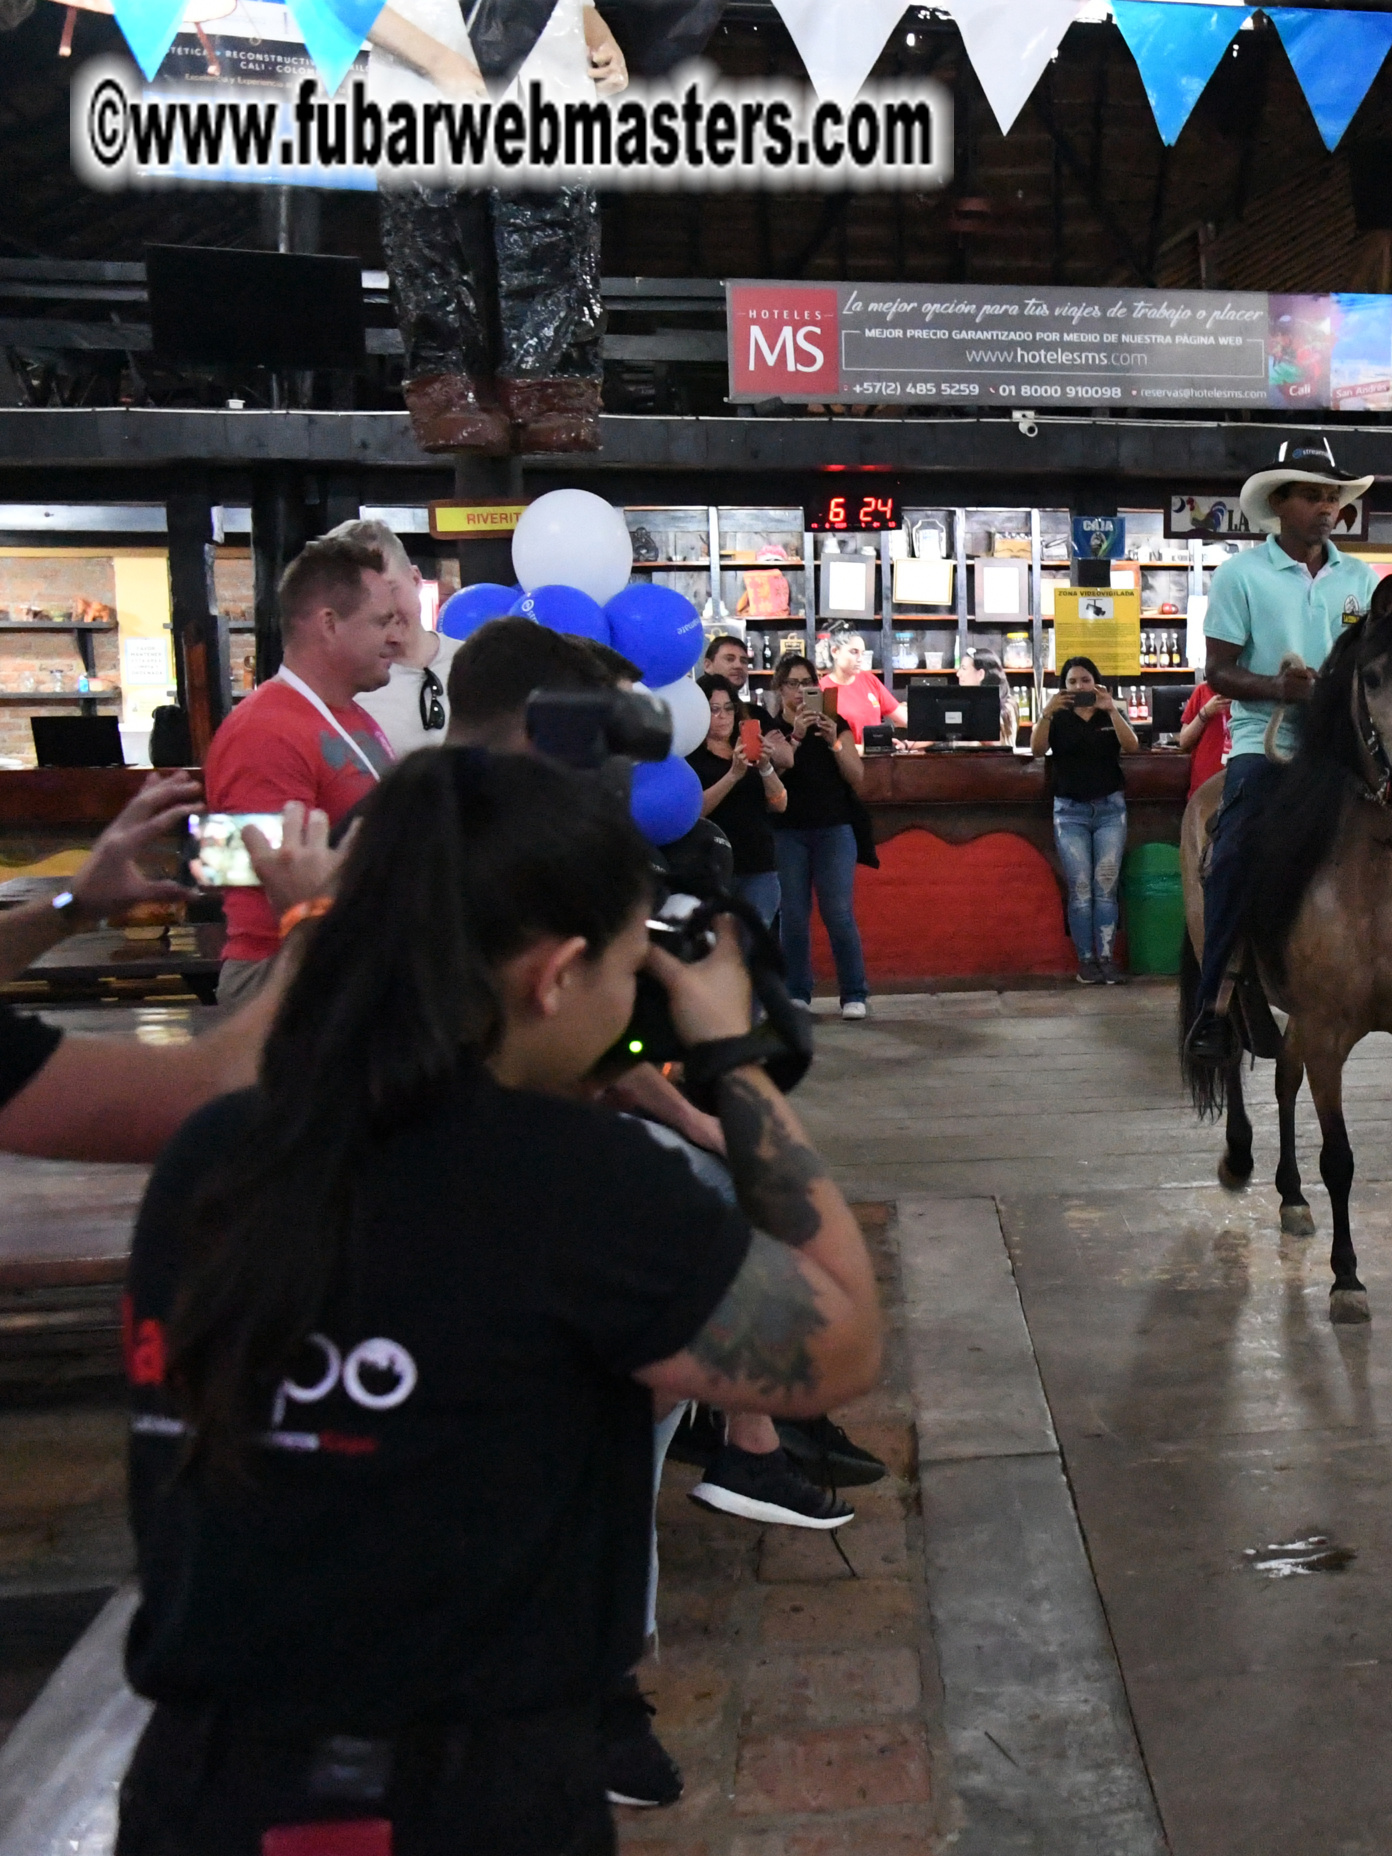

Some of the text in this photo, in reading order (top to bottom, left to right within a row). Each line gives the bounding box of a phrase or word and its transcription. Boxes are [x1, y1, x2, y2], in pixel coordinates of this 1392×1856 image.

[168, 45, 317, 66] TÉTICA RECONSTRUCTIV
[240, 61, 317, 76] CALI COLOM
[748, 309, 822, 320] HOTELES
[842, 290, 863, 315] La
[867, 298, 918, 322] mejor
[921, 299, 977, 322] opción
[976, 303, 1020, 324] para
[1054, 302, 1101, 325] viajes
[1107, 299, 1127, 318] de
[1132, 299, 1191, 328] trabajo
[1196, 309, 1206, 320] o
[1207, 303, 1265, 329] placer
[864, 328, 904, 339] MEJOR
[906, 329, 949, 340] PRECIO
[951, 330, 1033, 342] GARANTIZADO
[1036, 332, 1060, 343] POR
[1063, 333, 1099, 344] MEDIO
[1102, 333, 1119, 344] DE
[1121, 334, 1173, 345] NUESTRA
[1218, 336, 1243, 346] WEB
[748, 325, 825, 373] MS
[965, 346, 1148, 367] www.hotelesms.com
[852, 381, 1267, 401] +57(2) 485 5259 01 8000 910098 reservas@hotelesms.com
[1288, 384, 1311, 397] Cali
[1336, 389, 1353, 399] San
[466, 512, 522, 525] RIVERIT
[829, 497, 893, 522] 6 24
[1227, 509, 1250, 532] LA
[1080, 590, 1135, 598] VIDEOVIGILADA
